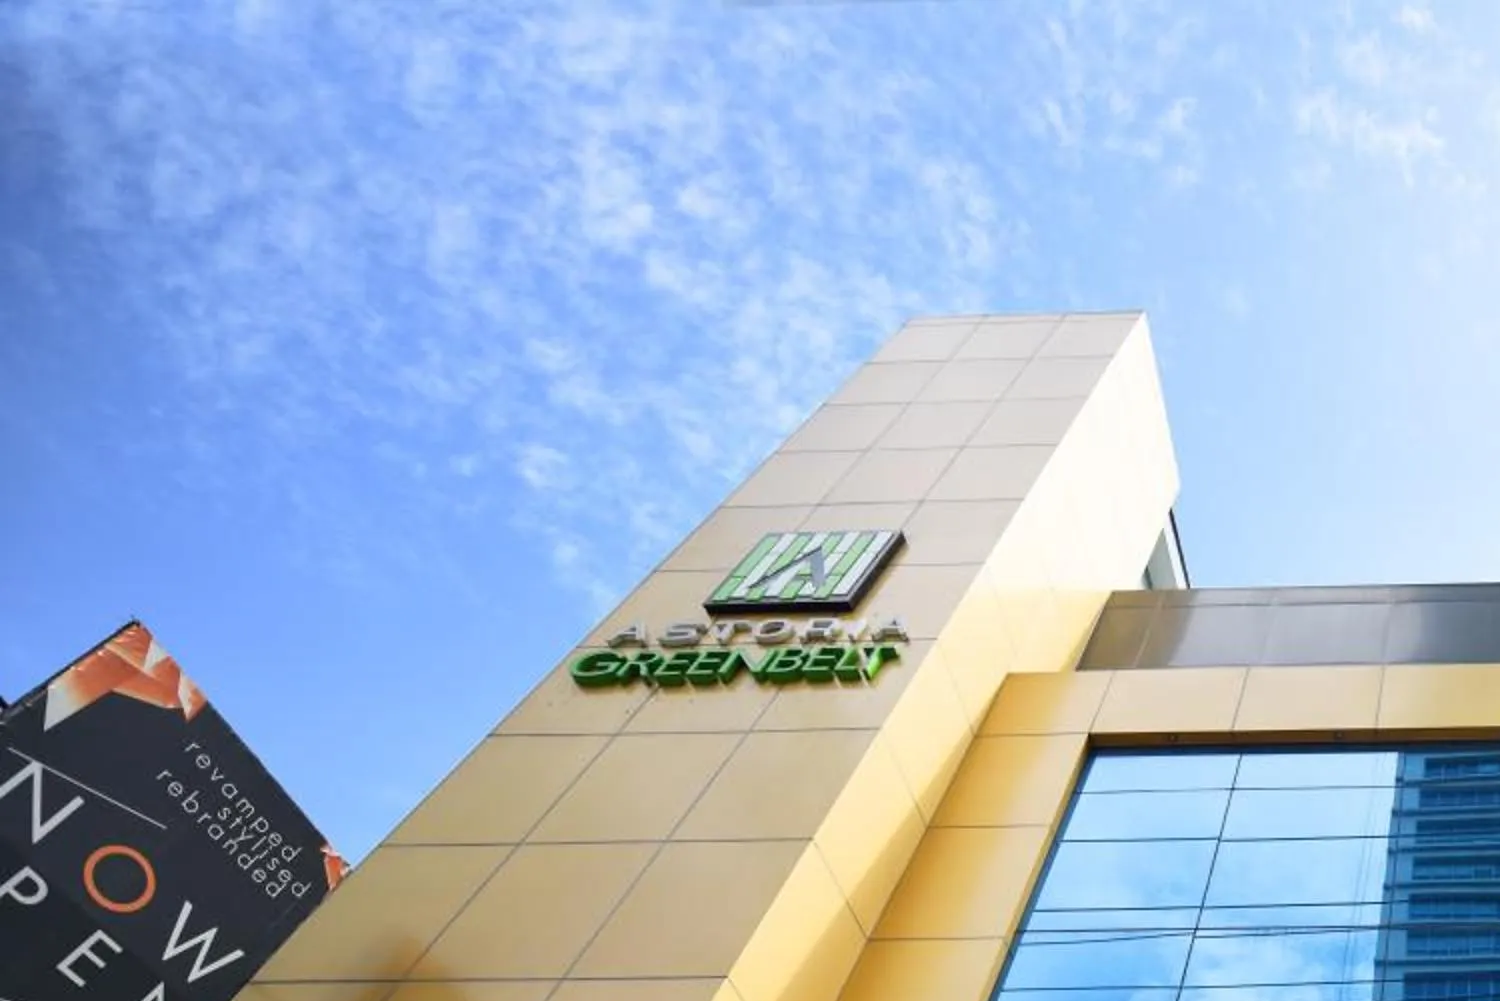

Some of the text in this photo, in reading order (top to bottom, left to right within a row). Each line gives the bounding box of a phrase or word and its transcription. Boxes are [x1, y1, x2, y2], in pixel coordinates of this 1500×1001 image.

[570, 642, 903, 688] GREENBELT
[607, 615, 910, 649] ASTORIA
[155, 768, 286, 900] rebranded
[183, 739, 303, 865] revamped
[216, 804, 311, 898] stylised
[0, 761, 245, 984] NOW
